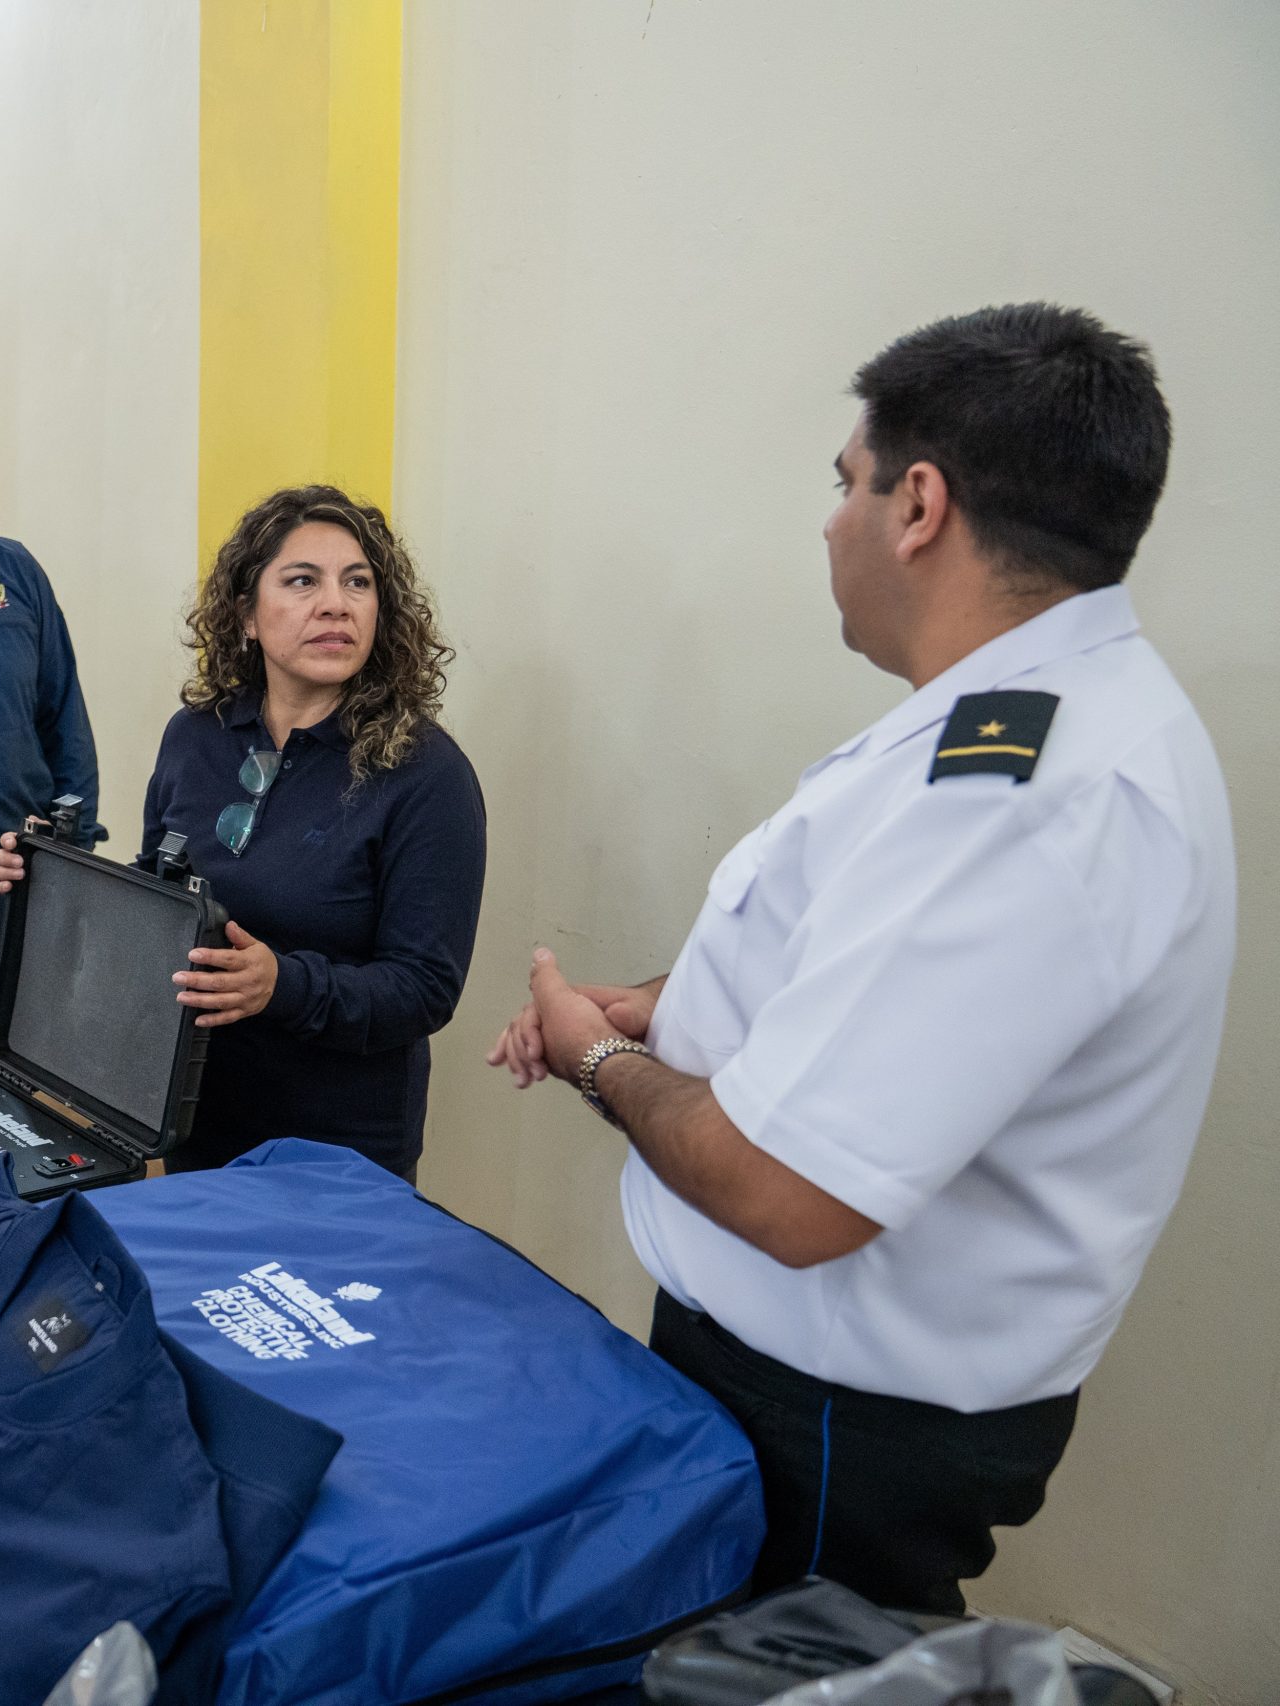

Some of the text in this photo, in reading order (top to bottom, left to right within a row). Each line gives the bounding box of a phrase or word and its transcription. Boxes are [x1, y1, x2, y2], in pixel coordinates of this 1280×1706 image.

[191, 1298, 279, 1360] CLOTHING
[201, 1289, 309, 1361] PROTECTIVE
[226, 1285, 314, 1351] CHEMICAL
[250, 1261, 376, 1345] Lakeland
